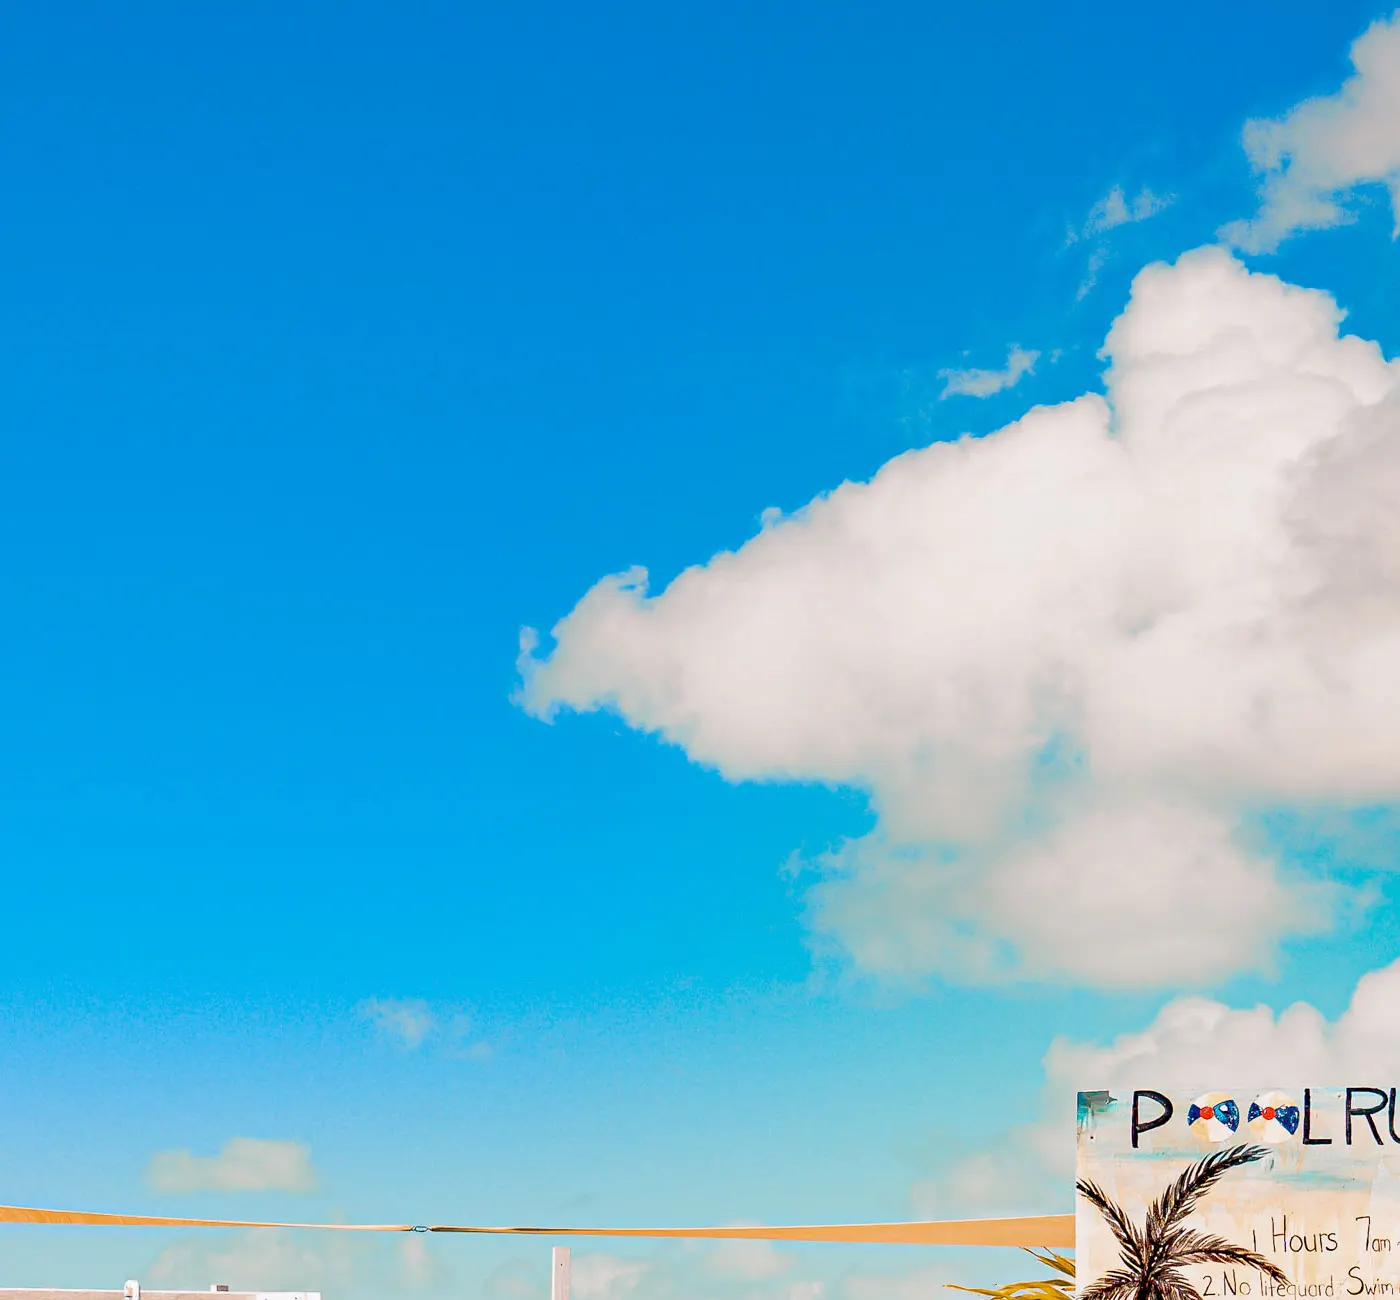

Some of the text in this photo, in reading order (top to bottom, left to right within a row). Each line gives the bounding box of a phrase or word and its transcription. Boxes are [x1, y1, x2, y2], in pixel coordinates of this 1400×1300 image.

[1271, 1215, 1338, 1253] Hours
[1223, 1269, 1251, 1296] No
[1346, 1266, 1394, 1295] Swim
